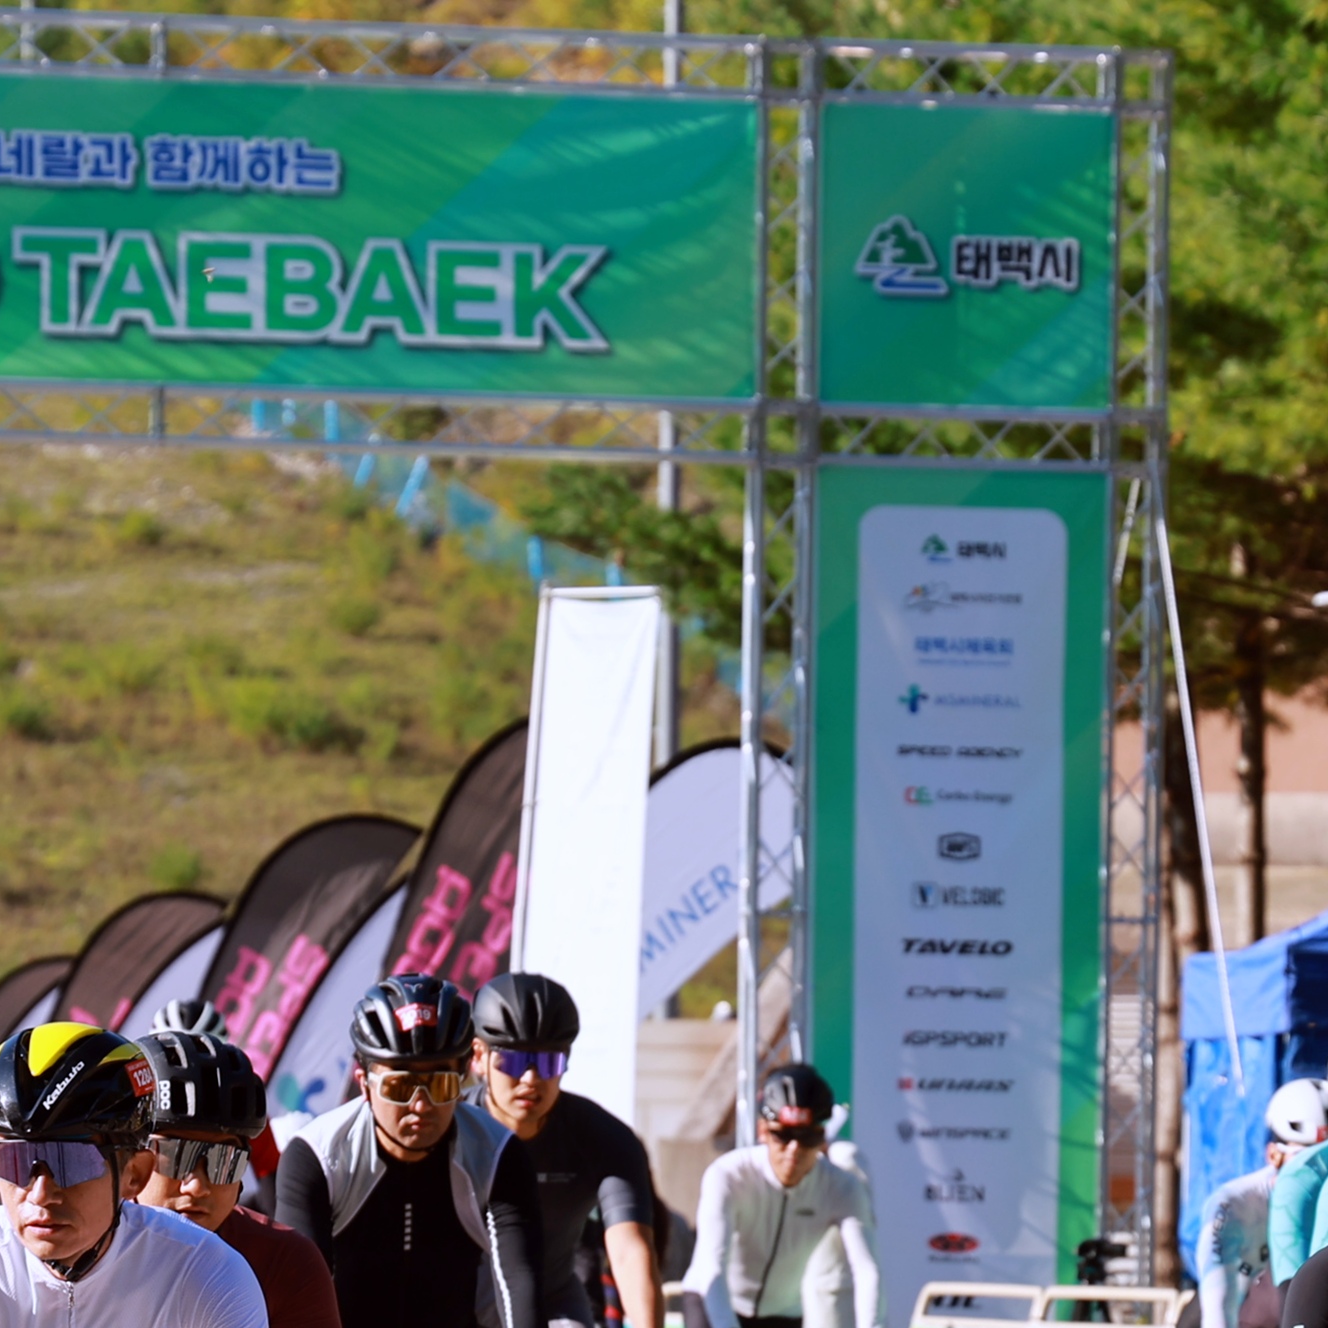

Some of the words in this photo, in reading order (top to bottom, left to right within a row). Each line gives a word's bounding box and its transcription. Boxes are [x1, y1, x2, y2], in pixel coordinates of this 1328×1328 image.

[145, 133, 342, 194] 함께하는
[951, 235, 1080, 291] 태백시
[12, 227, 609, 352] TAEBAEK
[902, 937, 1014, 957] TAVELO
[42, 1061, 85, 1110] Kabuto
[159, 1079, 171, 1110] POC
